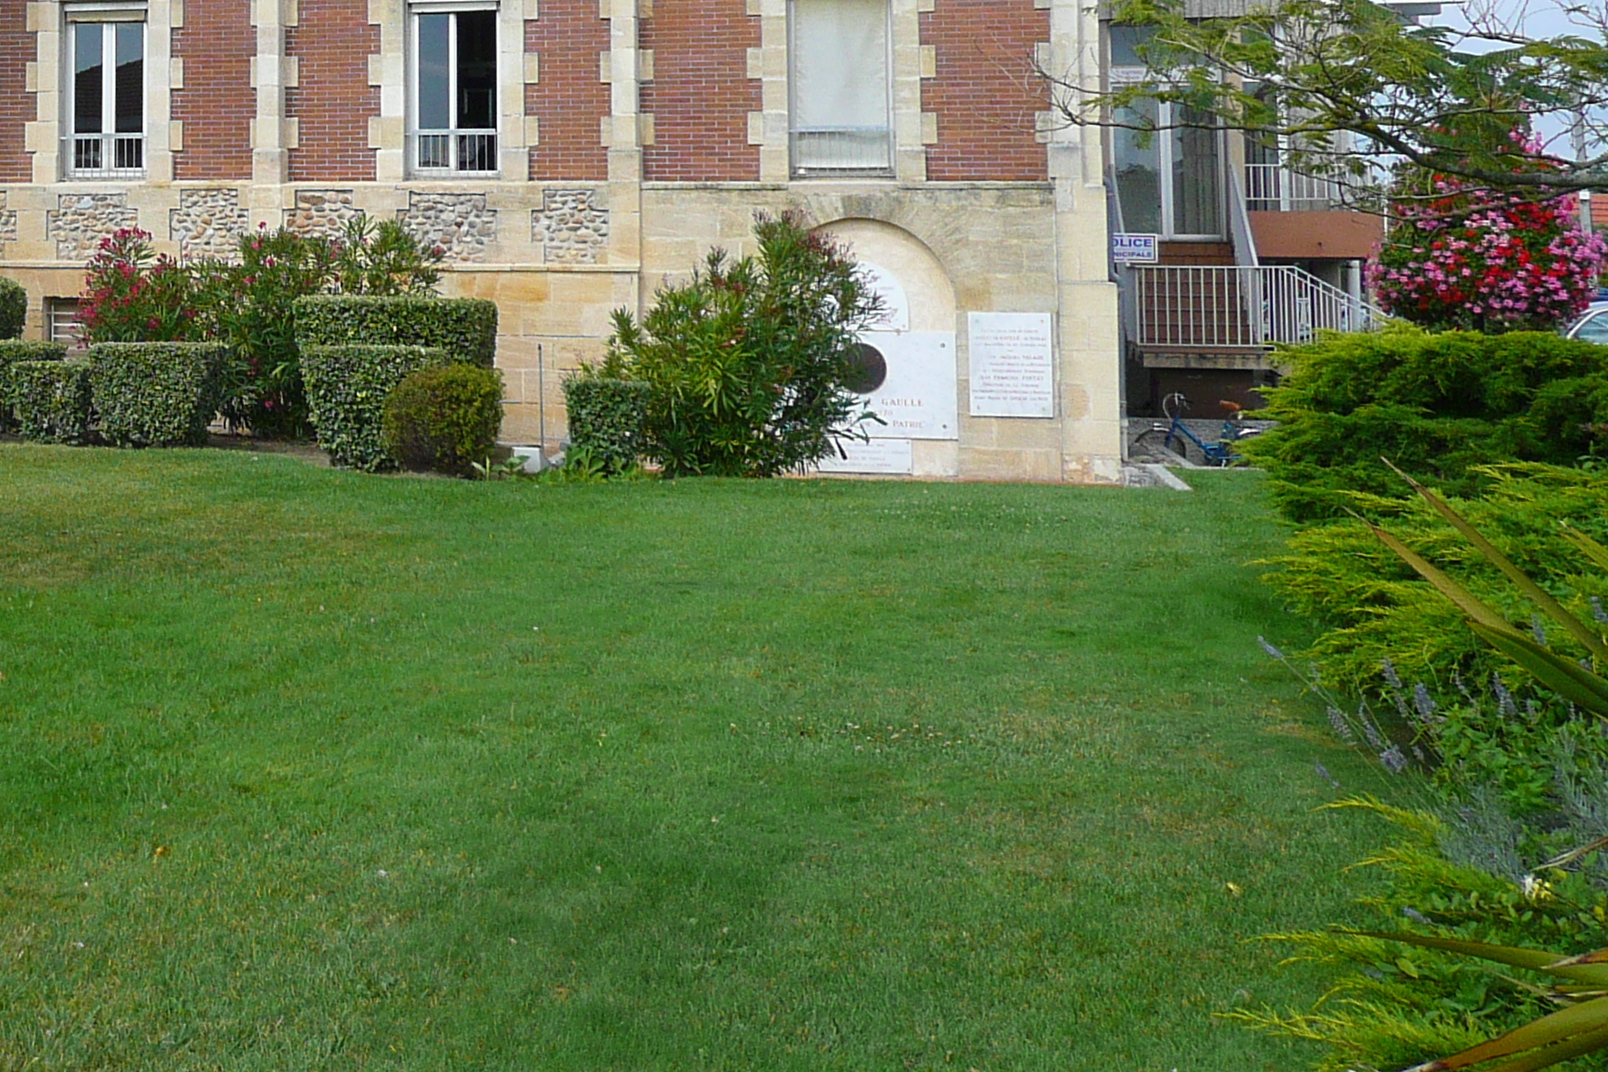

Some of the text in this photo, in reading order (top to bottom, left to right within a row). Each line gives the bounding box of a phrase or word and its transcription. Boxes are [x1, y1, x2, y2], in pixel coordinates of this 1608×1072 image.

[1112, 238, 1153, 247] OLICE
[881, 398, 924, 407] GAULLE
[892, 420, 923, 428] PATRIE
